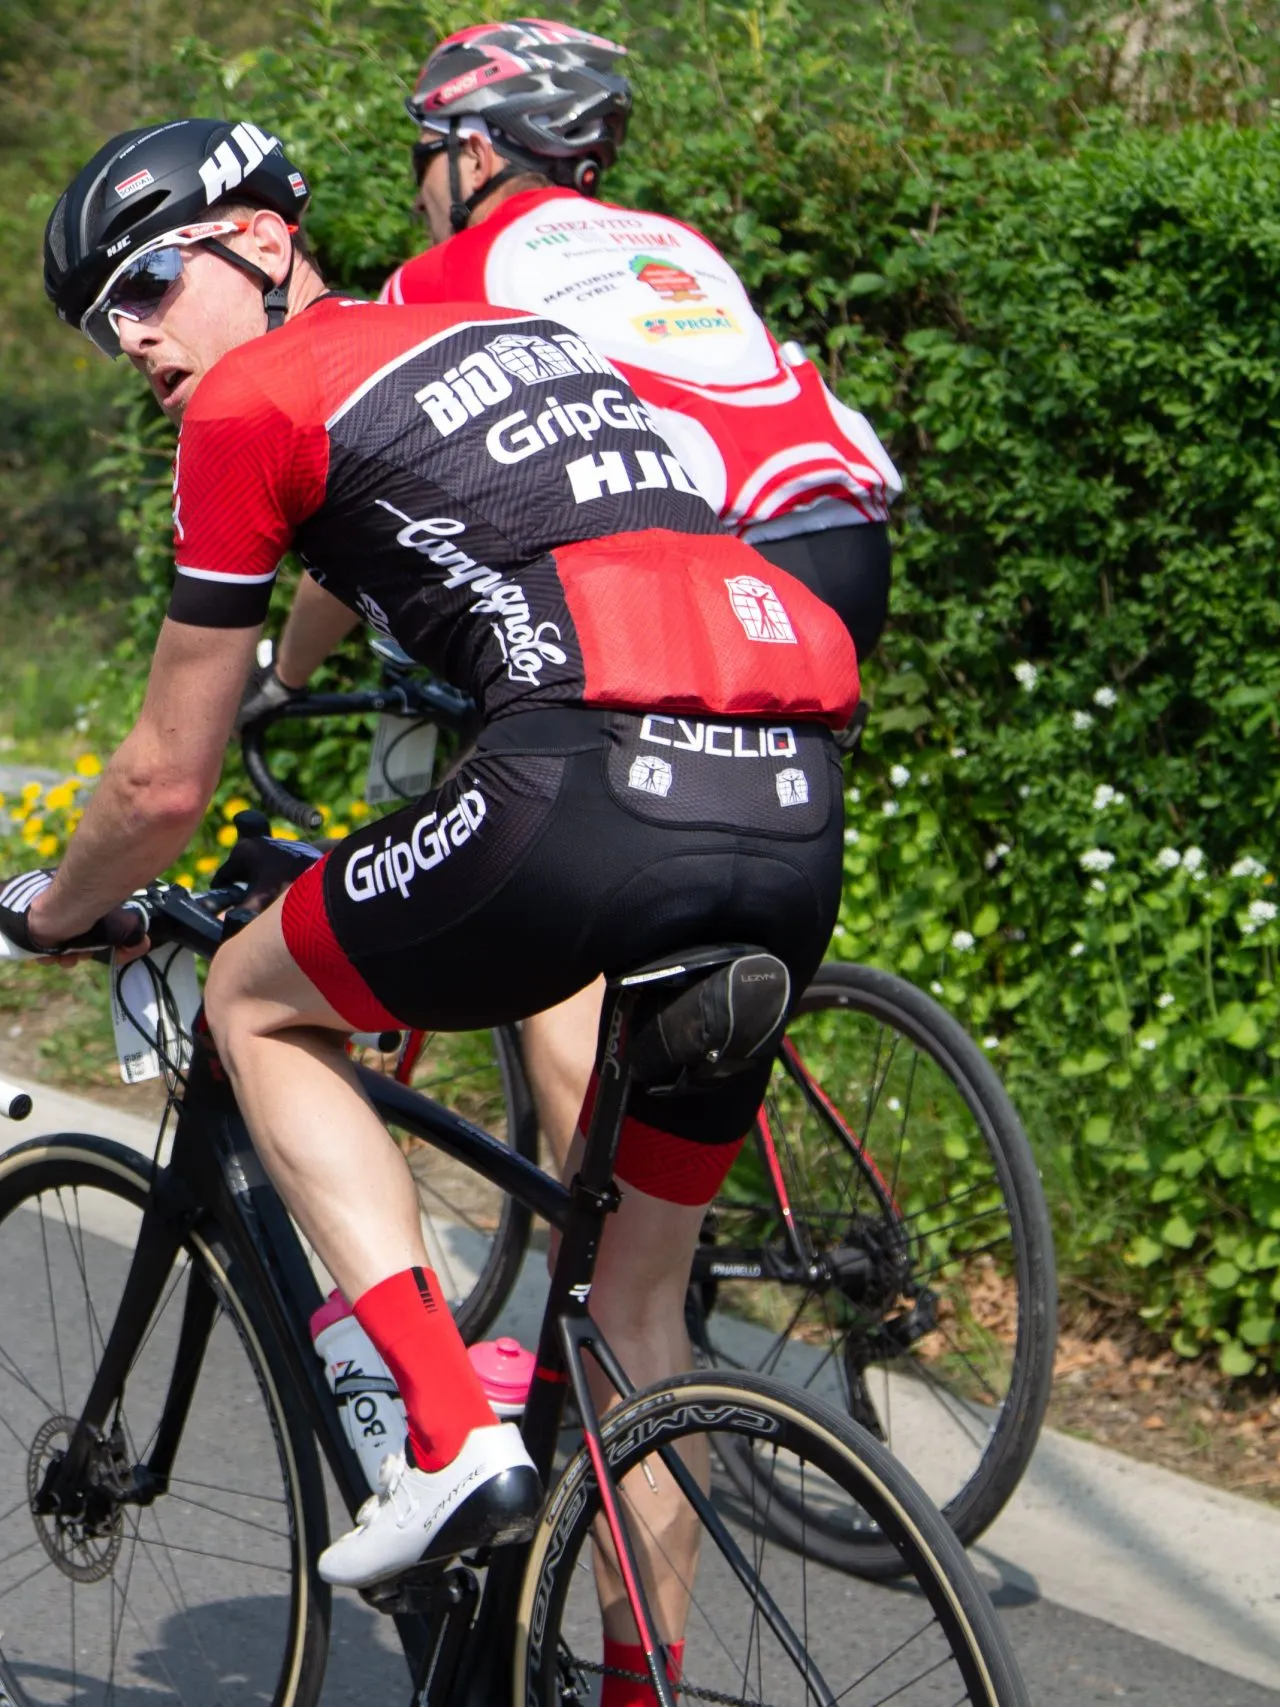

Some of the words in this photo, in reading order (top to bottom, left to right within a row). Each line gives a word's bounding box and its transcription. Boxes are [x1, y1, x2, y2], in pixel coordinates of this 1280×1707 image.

[592, 218, 643, 229] VITO
[106, 235, 131, 258] HJC
[740, 973, 777, 984] LEZYNE
[331, 1359, 387, 1438] BON
